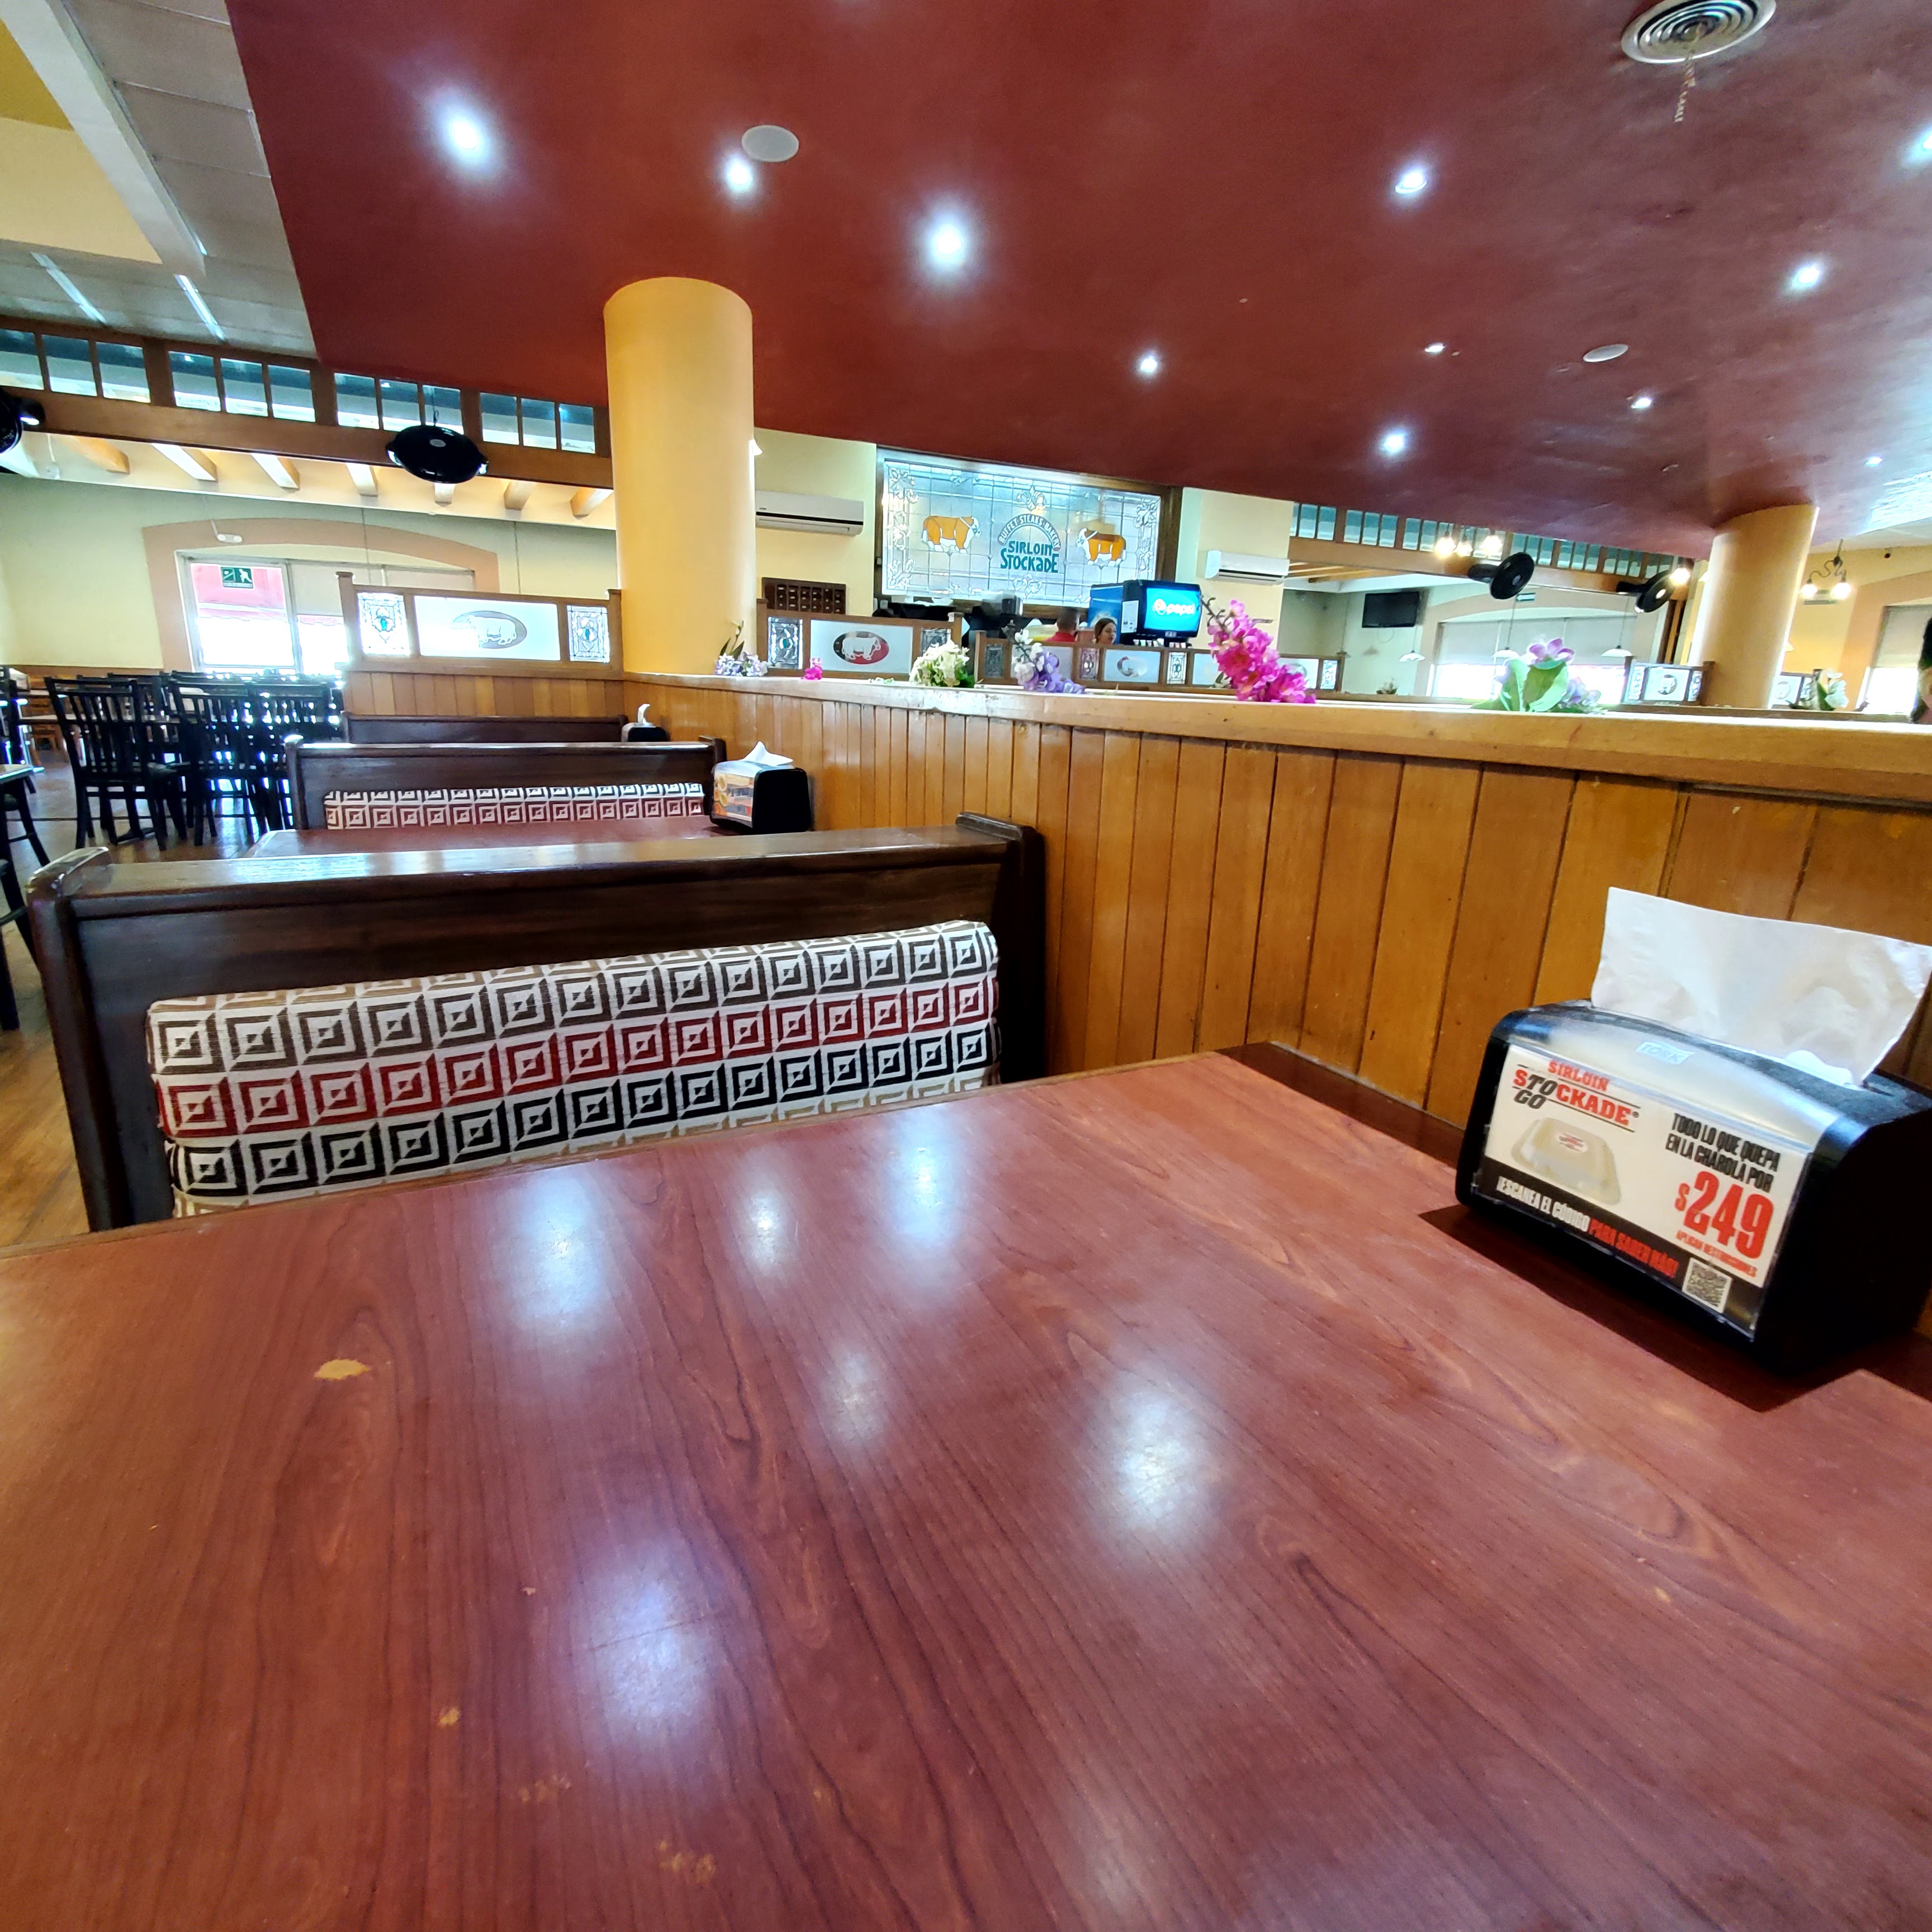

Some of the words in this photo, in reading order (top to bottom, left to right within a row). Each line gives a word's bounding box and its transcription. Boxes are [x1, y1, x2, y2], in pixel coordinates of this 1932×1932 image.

[998, 518, 1019, 543] BUFFET
[1019, 514, 1044, 526] STEAKS
[1044, 522, 1061, 548] BAKERY
[1547, 1060, 1610, 1091] SIRLOIN
[1513, 1089, 1547, 1110] GO
[1665, 1133, 1682, 1154] EN
[1679, 1138, 1694, 1160] LA
[1693, 1145, 1746, 1182] CHAROLA
[1745, 1166, 1774, 1194] POR
[1701, 1125, 1717, 1145] LO
[1716, 1131, 1741, 1156] QUE
[1740, 1140, 1781, 1172] QUEPA
[1540, 1195, 1552, 1214] EL
